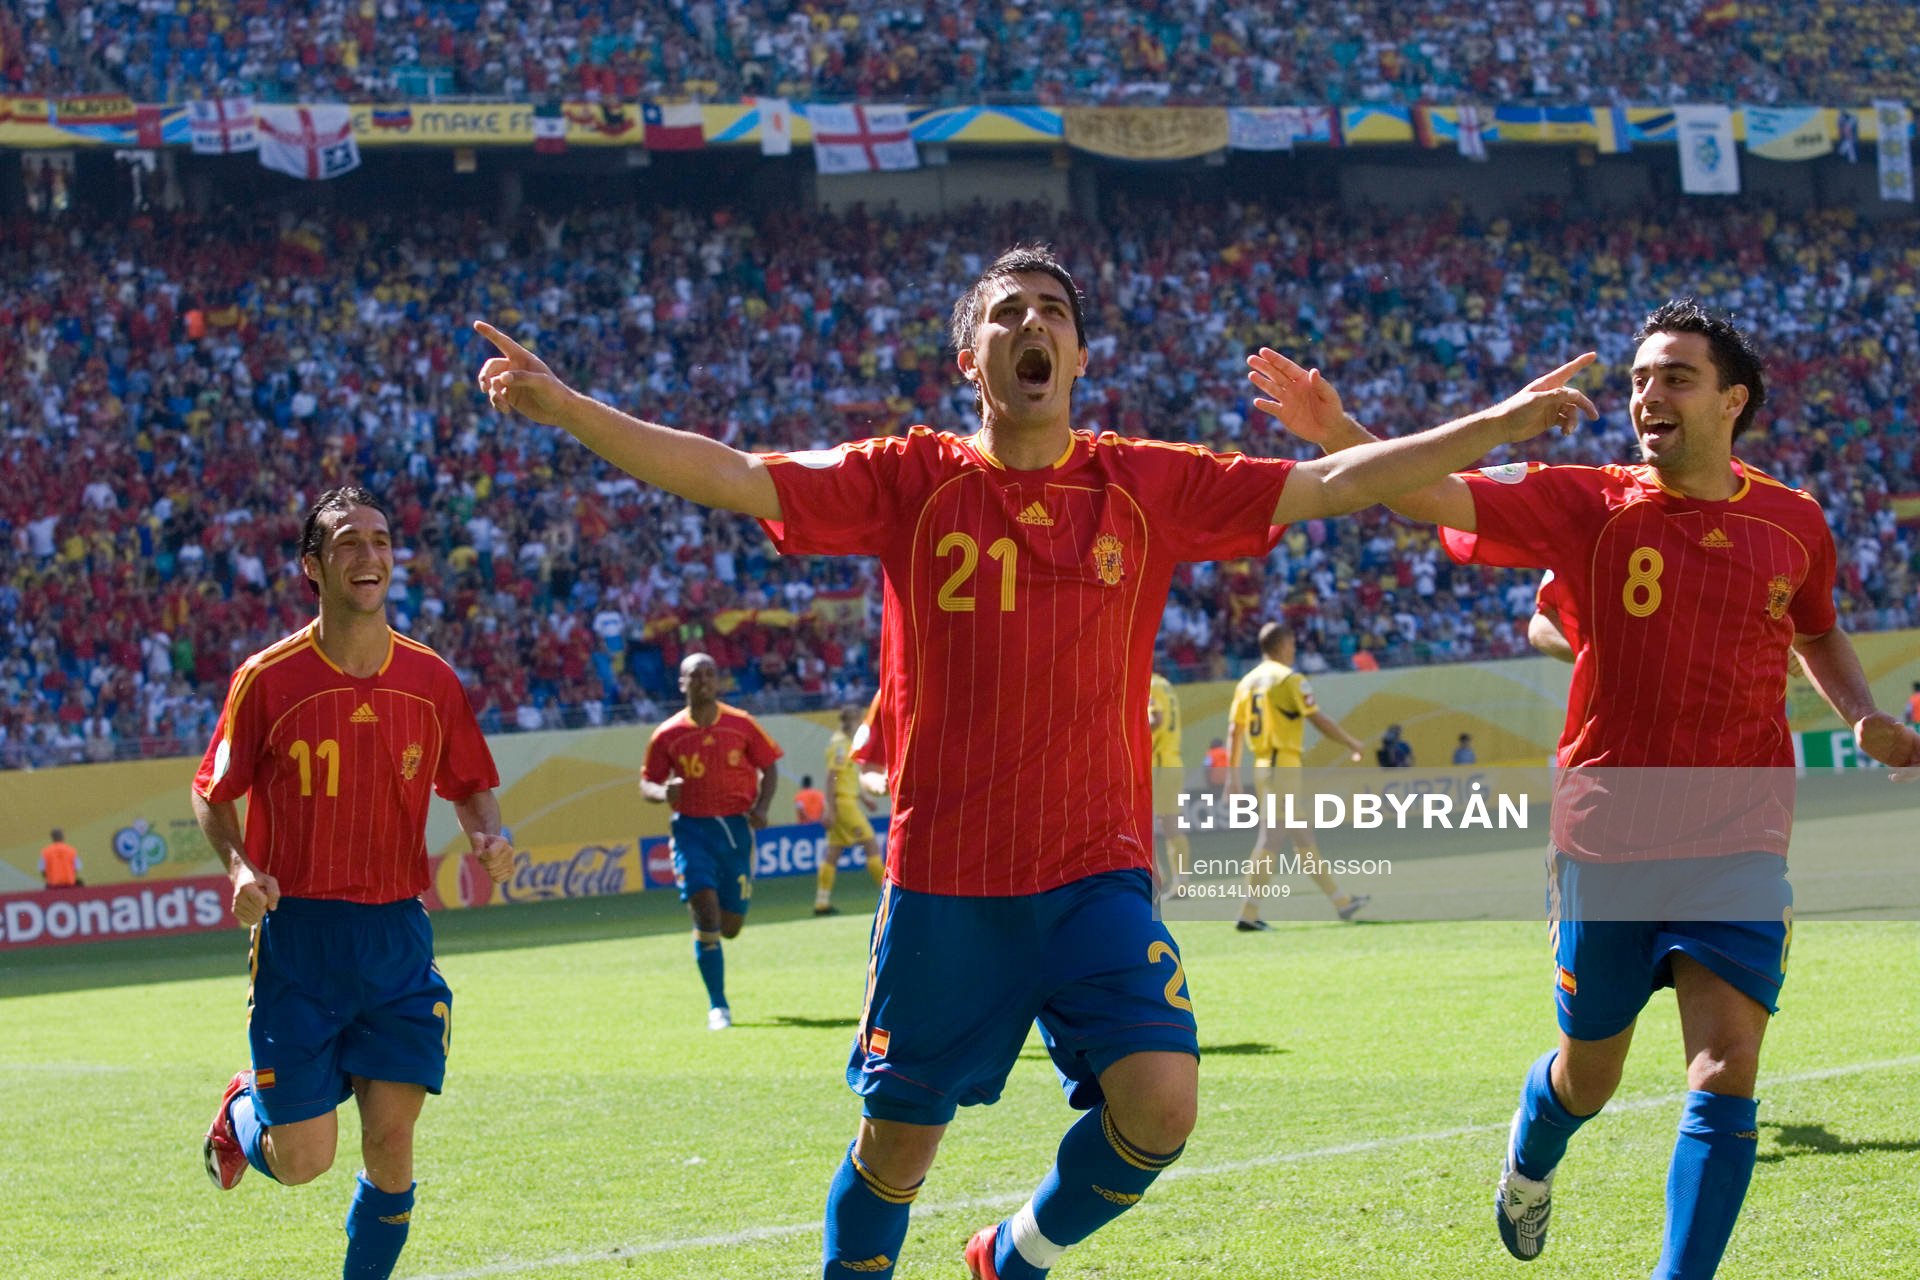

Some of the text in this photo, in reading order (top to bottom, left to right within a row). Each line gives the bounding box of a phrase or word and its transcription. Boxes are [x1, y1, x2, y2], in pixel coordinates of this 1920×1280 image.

[421, 111, 500, 134] MAKE
[1016, 515, 1055, 527] adidas
[935, 531, 1019, 612] 21
[1622, 546, 1665, 618] 8
[1250, 693, 1263, 737] 5
[288, 738, 340, 797] 11
[678, 752, 706, 778] 16
[0, 886, 222, 943] Donald's
[1147, 940, 1194, 1014] 2
